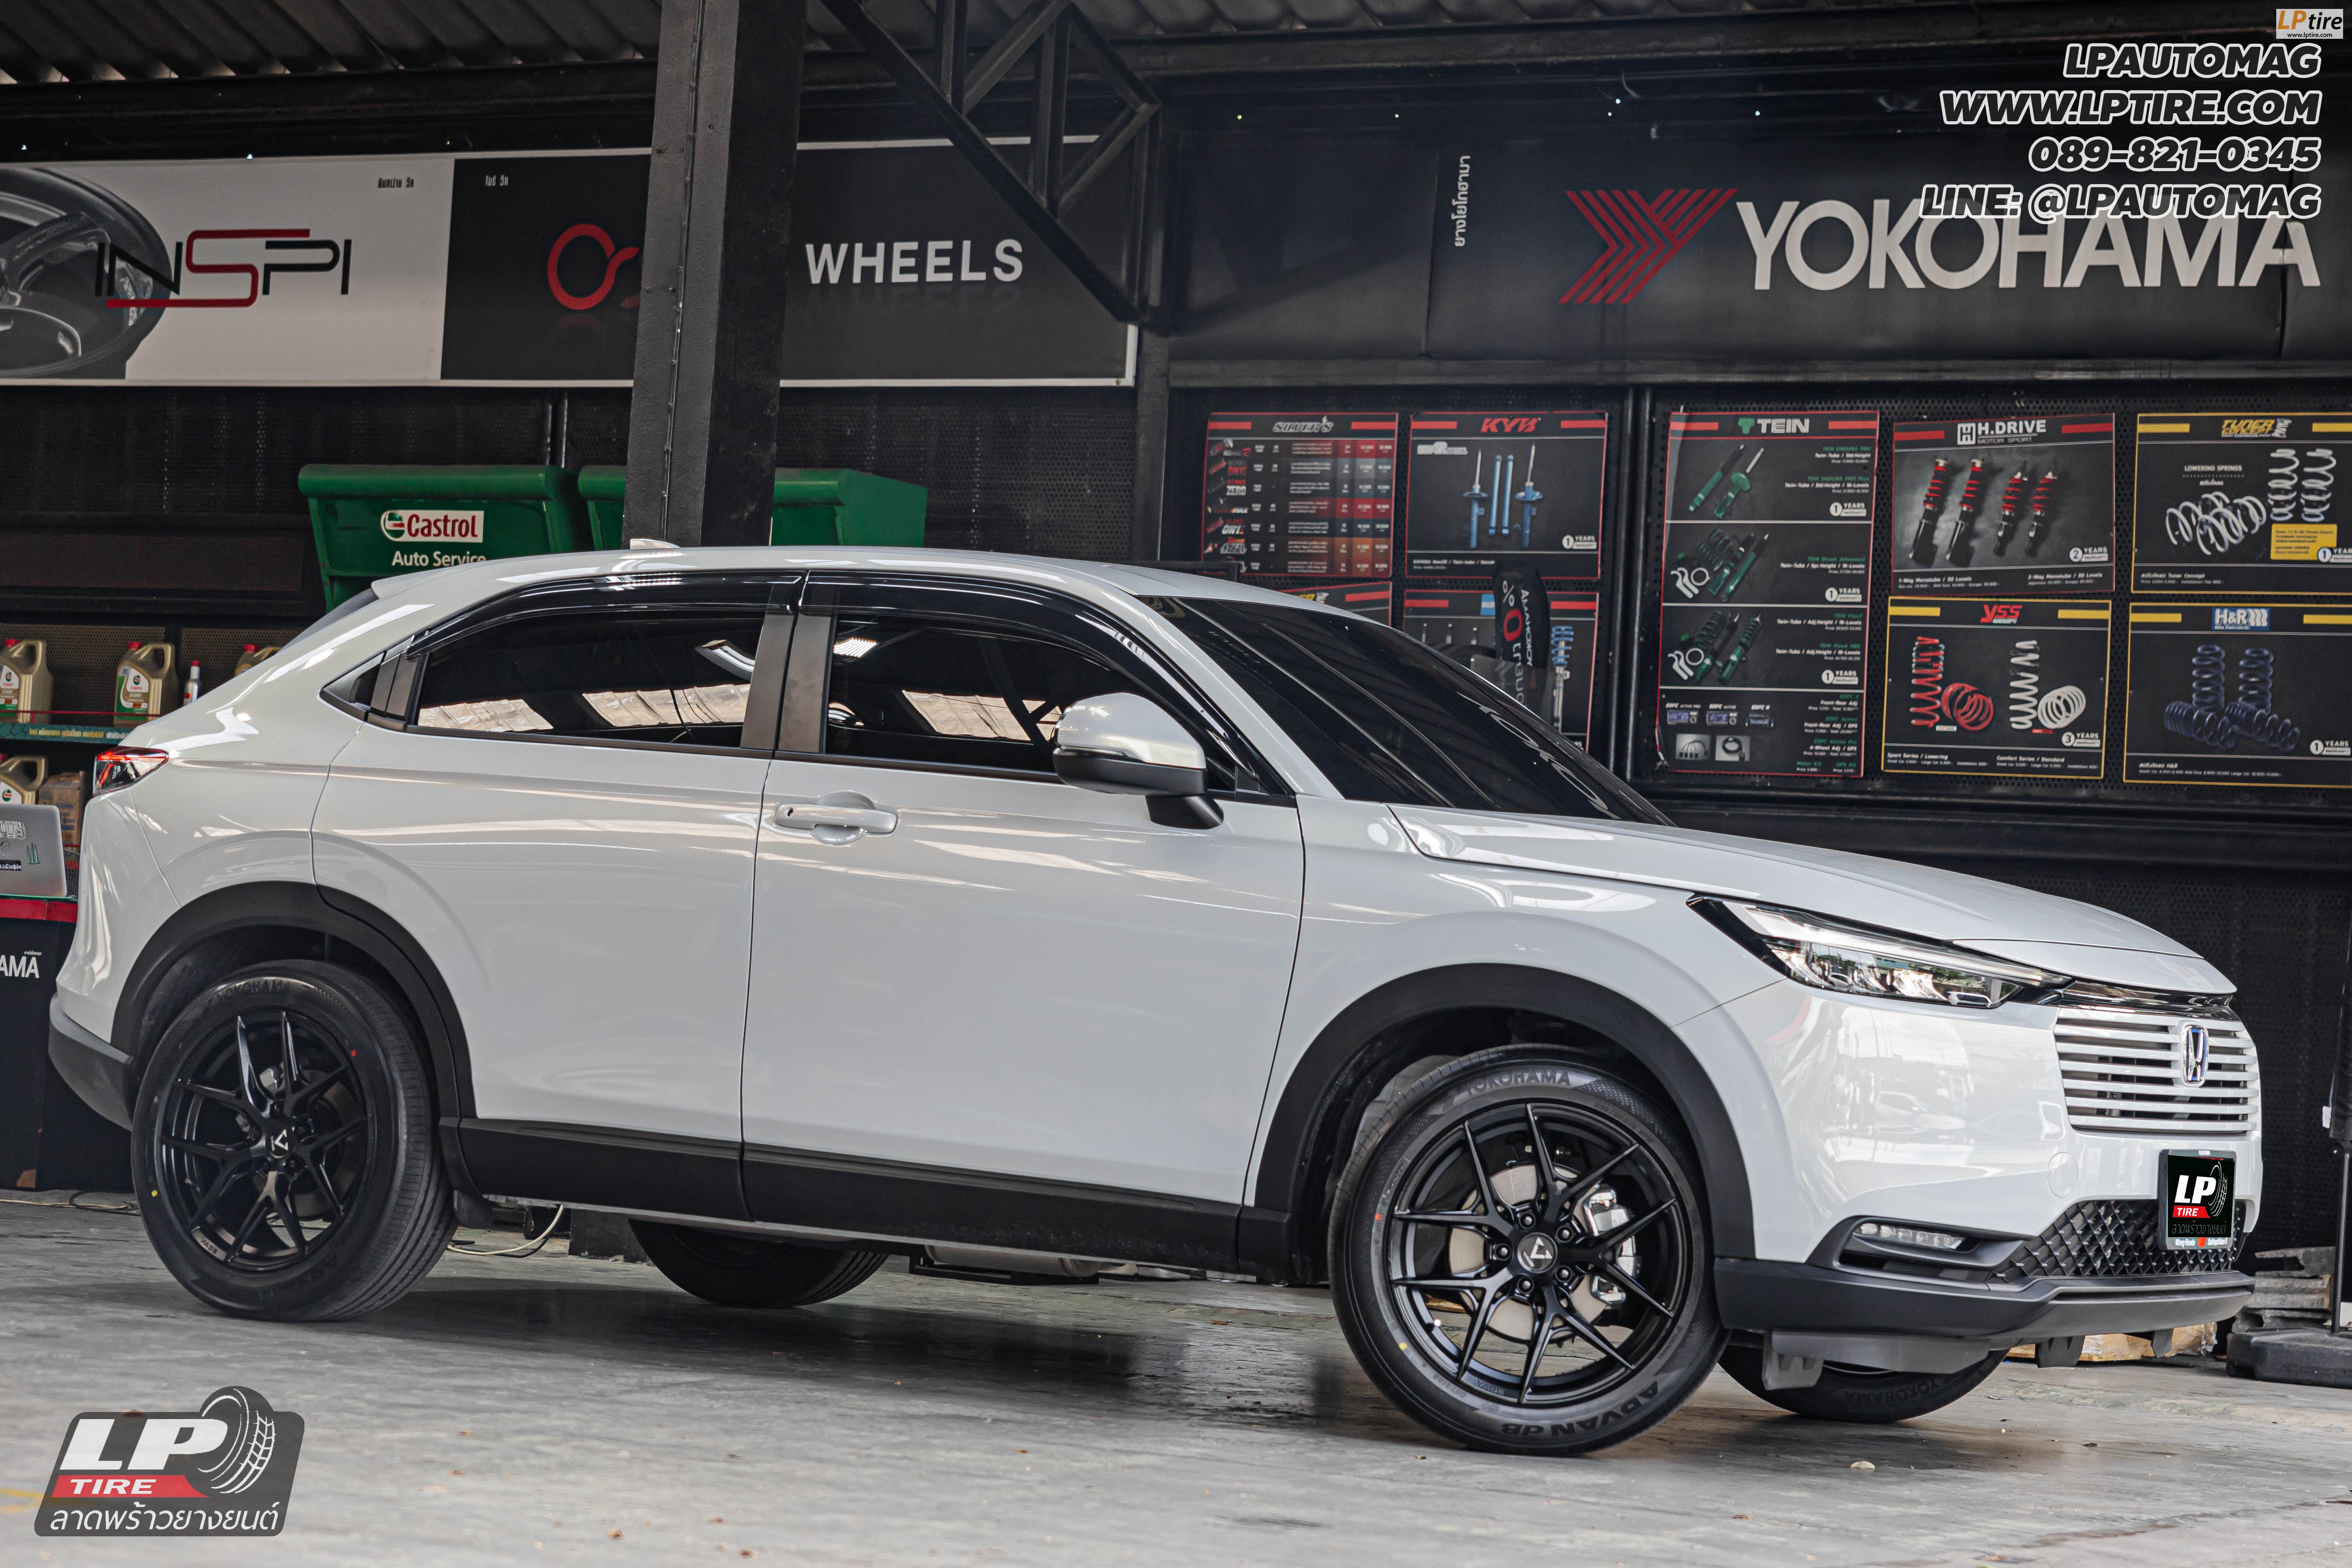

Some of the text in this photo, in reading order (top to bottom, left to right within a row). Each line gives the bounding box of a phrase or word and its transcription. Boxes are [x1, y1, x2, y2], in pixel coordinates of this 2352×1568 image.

[1451, 155, 1471, 246] ยางโยโกฮามา
[1736, 194, 2321, 291] YOKOHAMA
[95, 228, 352, 308] INSPI
[806, 238, 1023, 284] WHEELS
[1481, 417, 1538, 432] KYB
[1757, 418, 1810, 433] TEIN
[1978, 419, 2046, 435] H.DRIVE
[407, 514, 478, 538] Castrol
[392, 550, 486, 566] Auto Service
[2215, 608, 2247, 625] H&R
[1461, 1069, 1571, 1095] YOKOHAMA
[1844, 1378, 1943, 1404] YOKOHAMA
[1552, 1380, 1659, 1437] ADVAN
